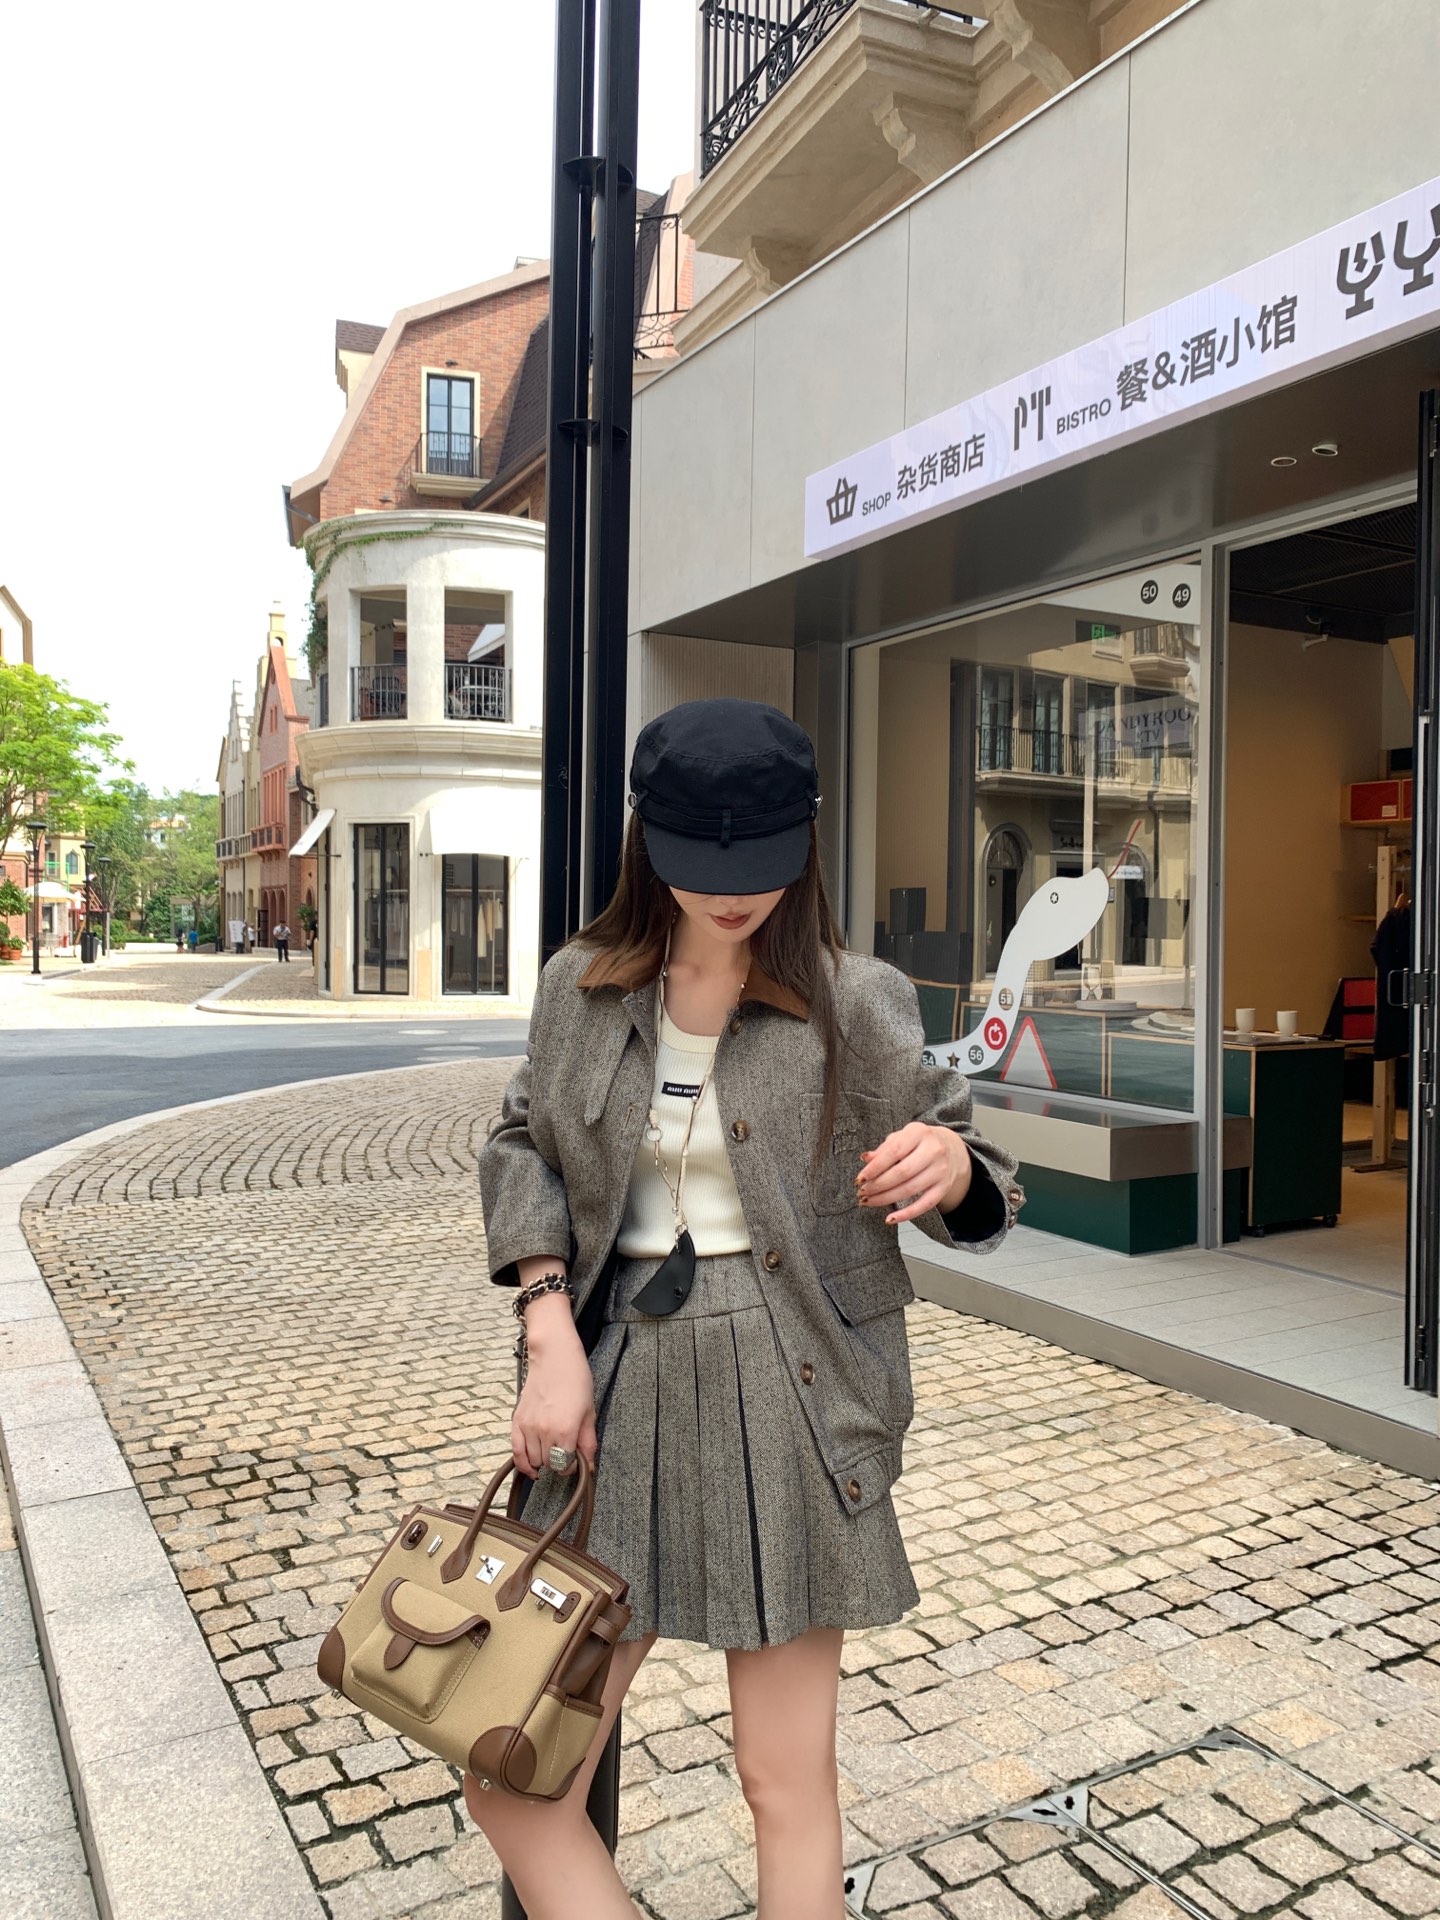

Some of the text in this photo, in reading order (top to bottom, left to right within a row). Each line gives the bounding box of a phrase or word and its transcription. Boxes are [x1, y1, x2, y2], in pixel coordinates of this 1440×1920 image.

[862, 295, 1298, 516] SHOP 杂货商店 BISTRO 餐&酒小馆
[1142, 585, 1190, 603] 50 49
[970, 1050, 982, 1061] 56
